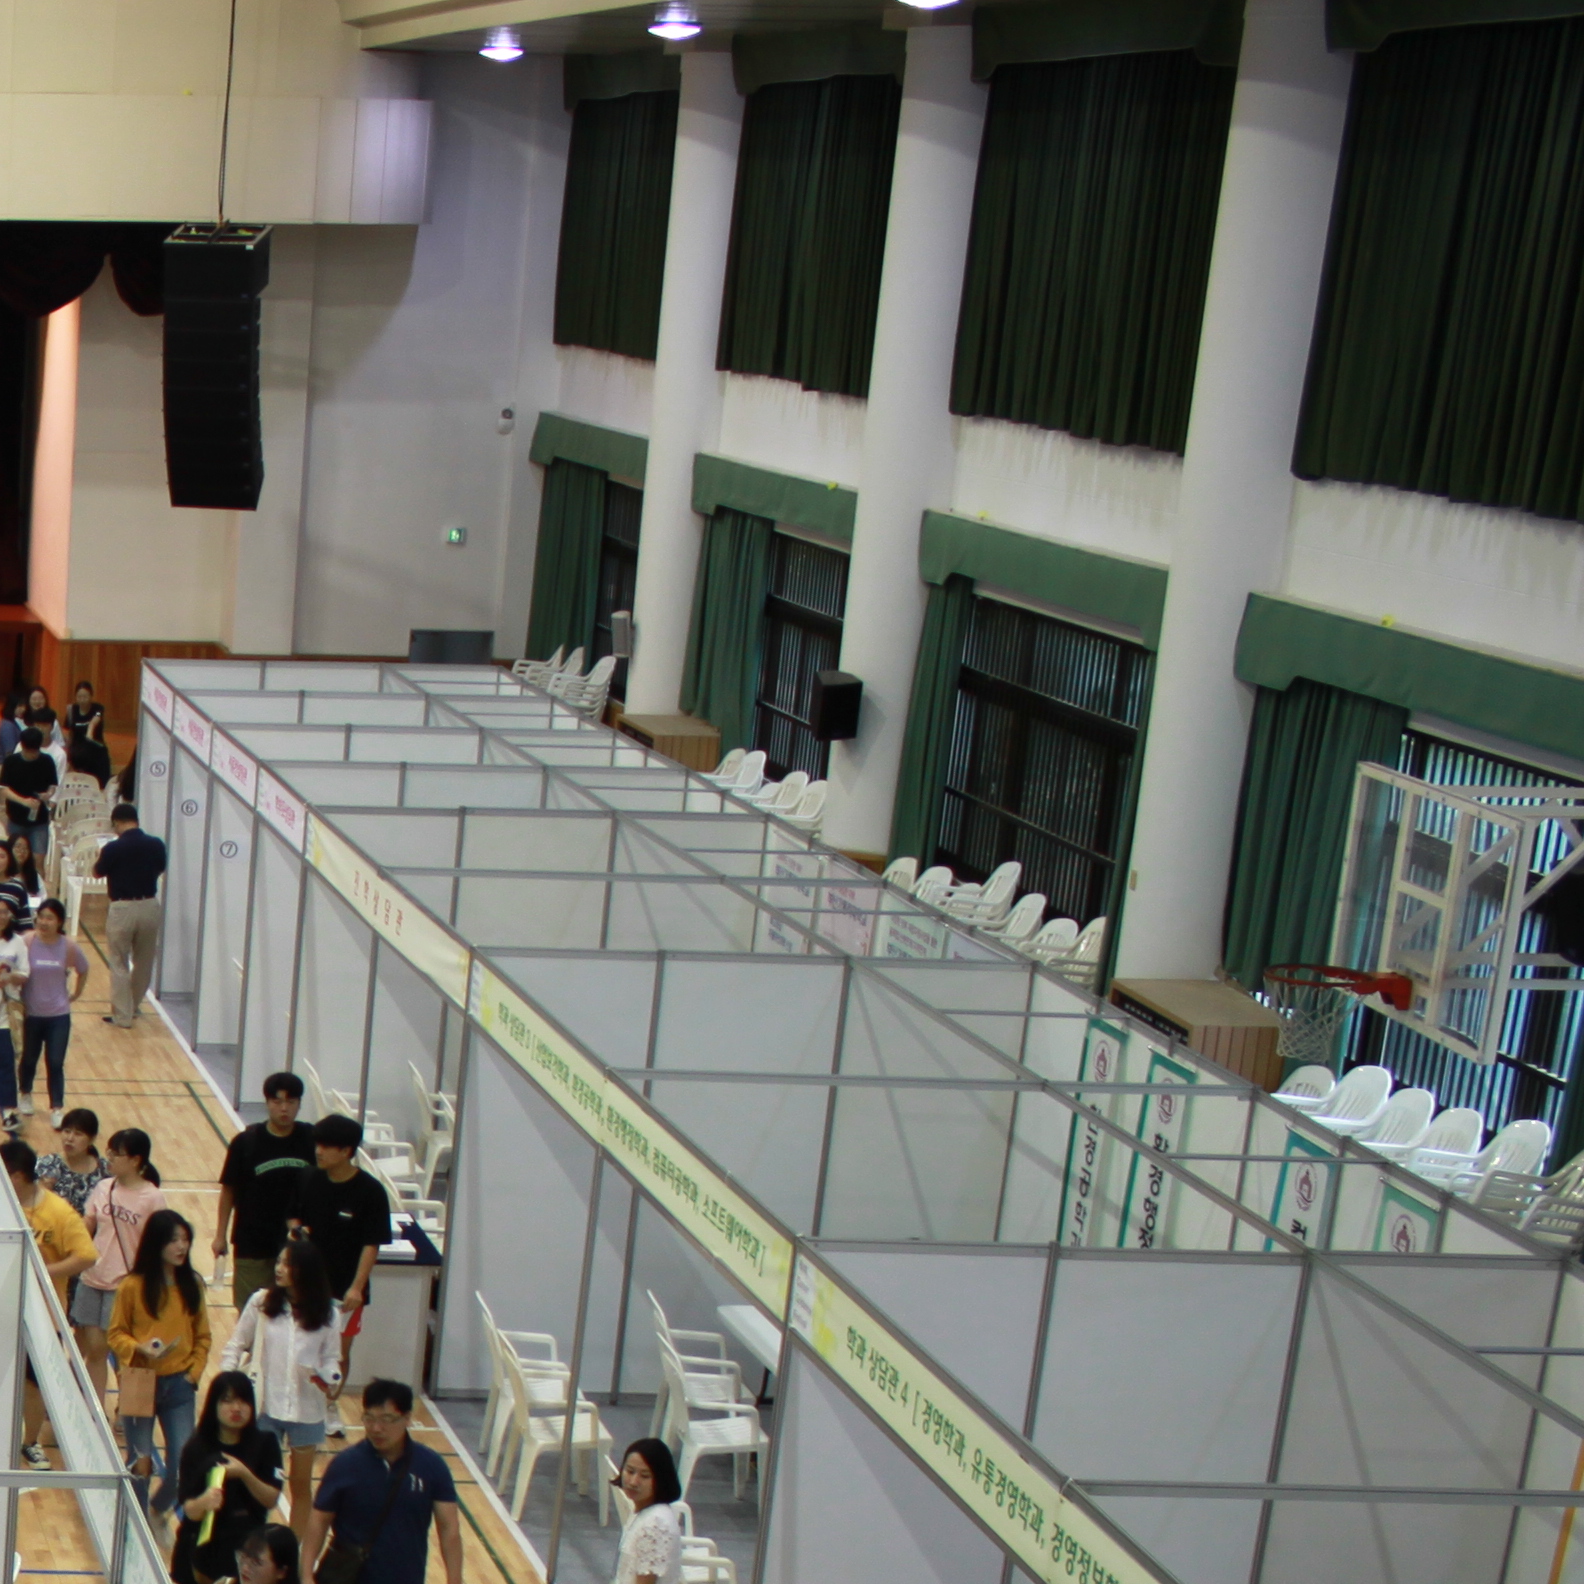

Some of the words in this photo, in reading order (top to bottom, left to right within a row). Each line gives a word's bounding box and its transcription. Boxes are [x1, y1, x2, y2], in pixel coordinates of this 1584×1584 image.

[846, 1326, 866, 1369] 학과
[869, 1348, 899, 1402] 상담관
[901, 1382, 908, 1407] 4
[971, 1448, 1045, 1548] 유통경영학과,
